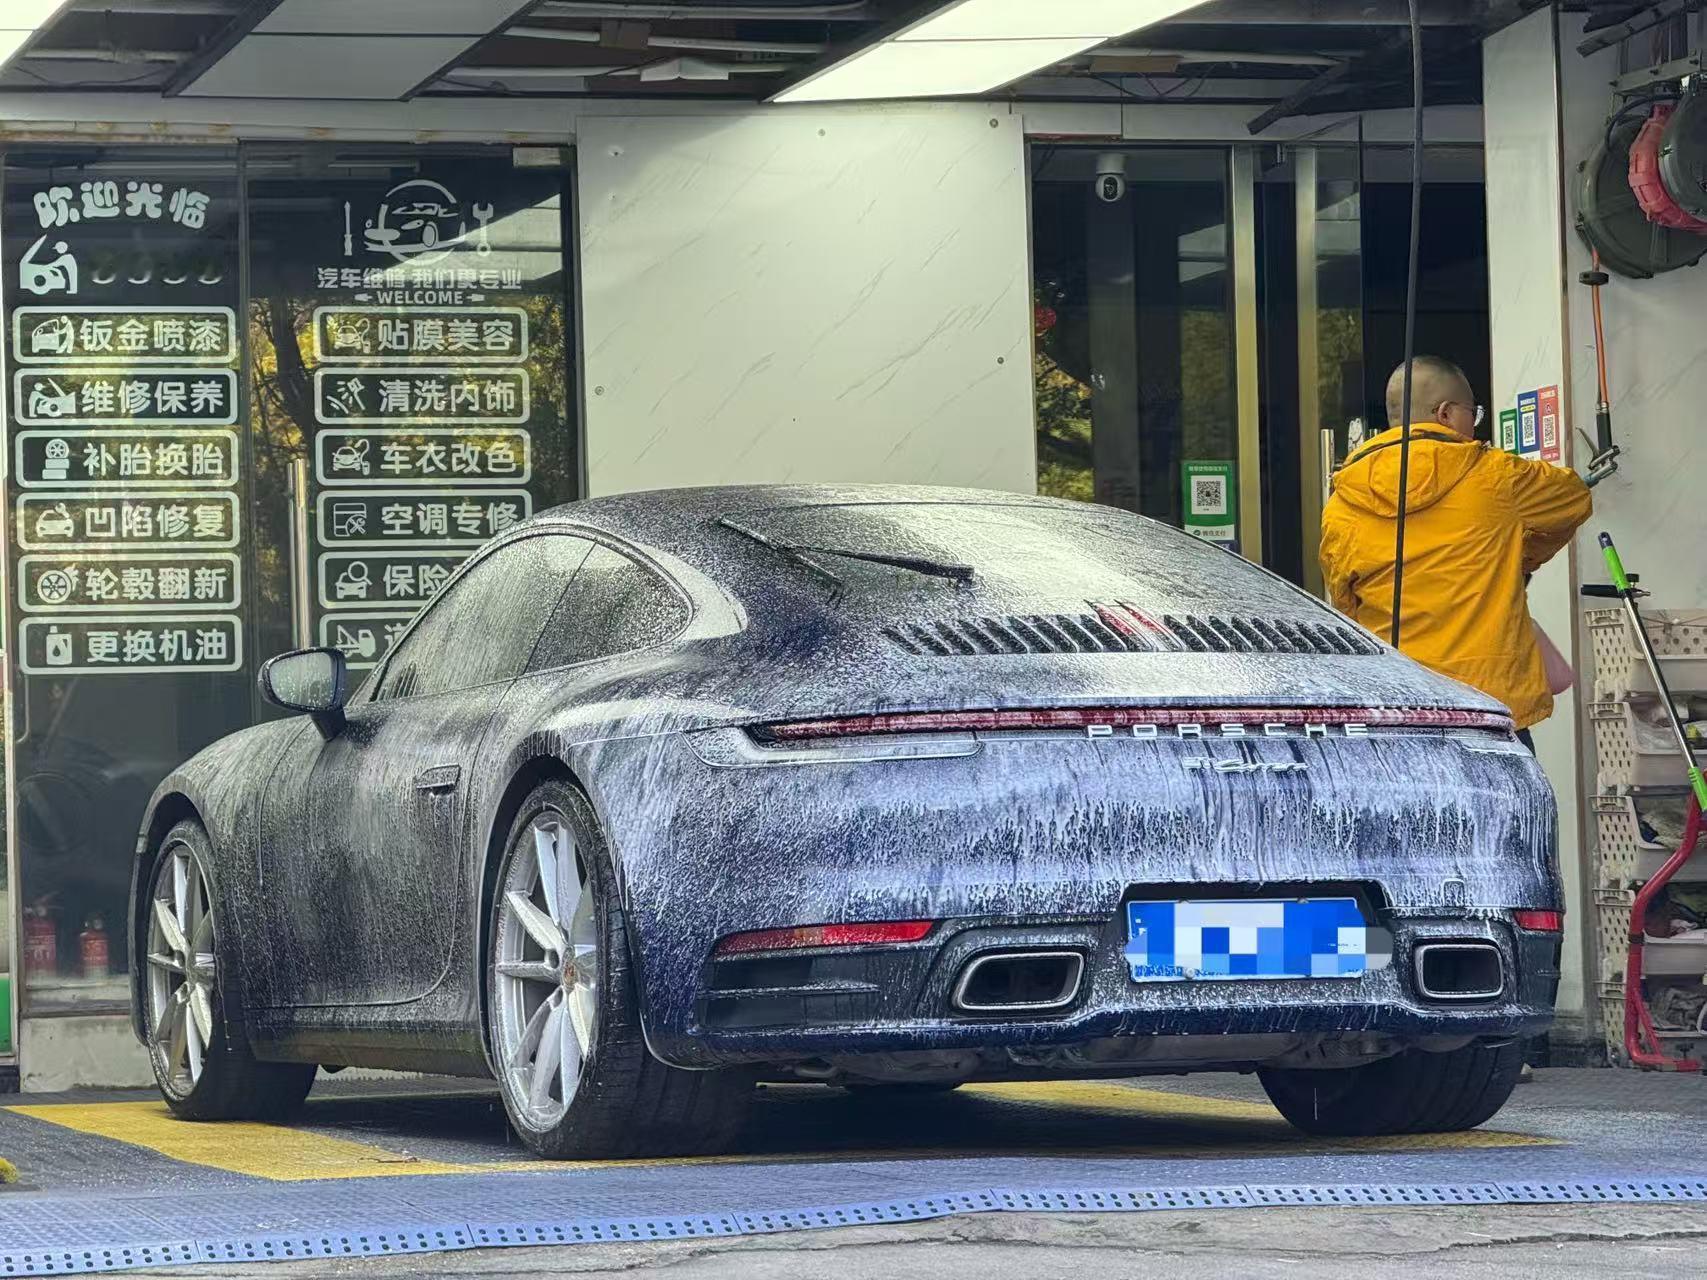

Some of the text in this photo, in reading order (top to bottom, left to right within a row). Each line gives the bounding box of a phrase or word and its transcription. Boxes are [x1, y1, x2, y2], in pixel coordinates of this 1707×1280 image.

[33, 181, 210, 229] 欢迎光临
[317, 268, 522, 289] 汽车维修 我们更专业
[377, 290, 464, 305] WELCOME
[79, 318, 221, 352] 钣金喷漆
[377, 318, 514, 351] 贴膜美容
[81, 380, 224, 414] 维修保养
[378, 379, 516, 412] 清洗内饰
[83, 442, 225, 477] 补胎换胎
[380, 442, 517, 475] 车衣改色
[85, 503, 226, 538] 凹陷修复
[381, 502, 519, 535] 空调专修
[85, 567, 227, 601] 轮毂翻新
[383, 563, 463, 597] 保险
[87, 628, 228, 663] 更换机油
[1087, 723, 1368, 738] PORSCHE
